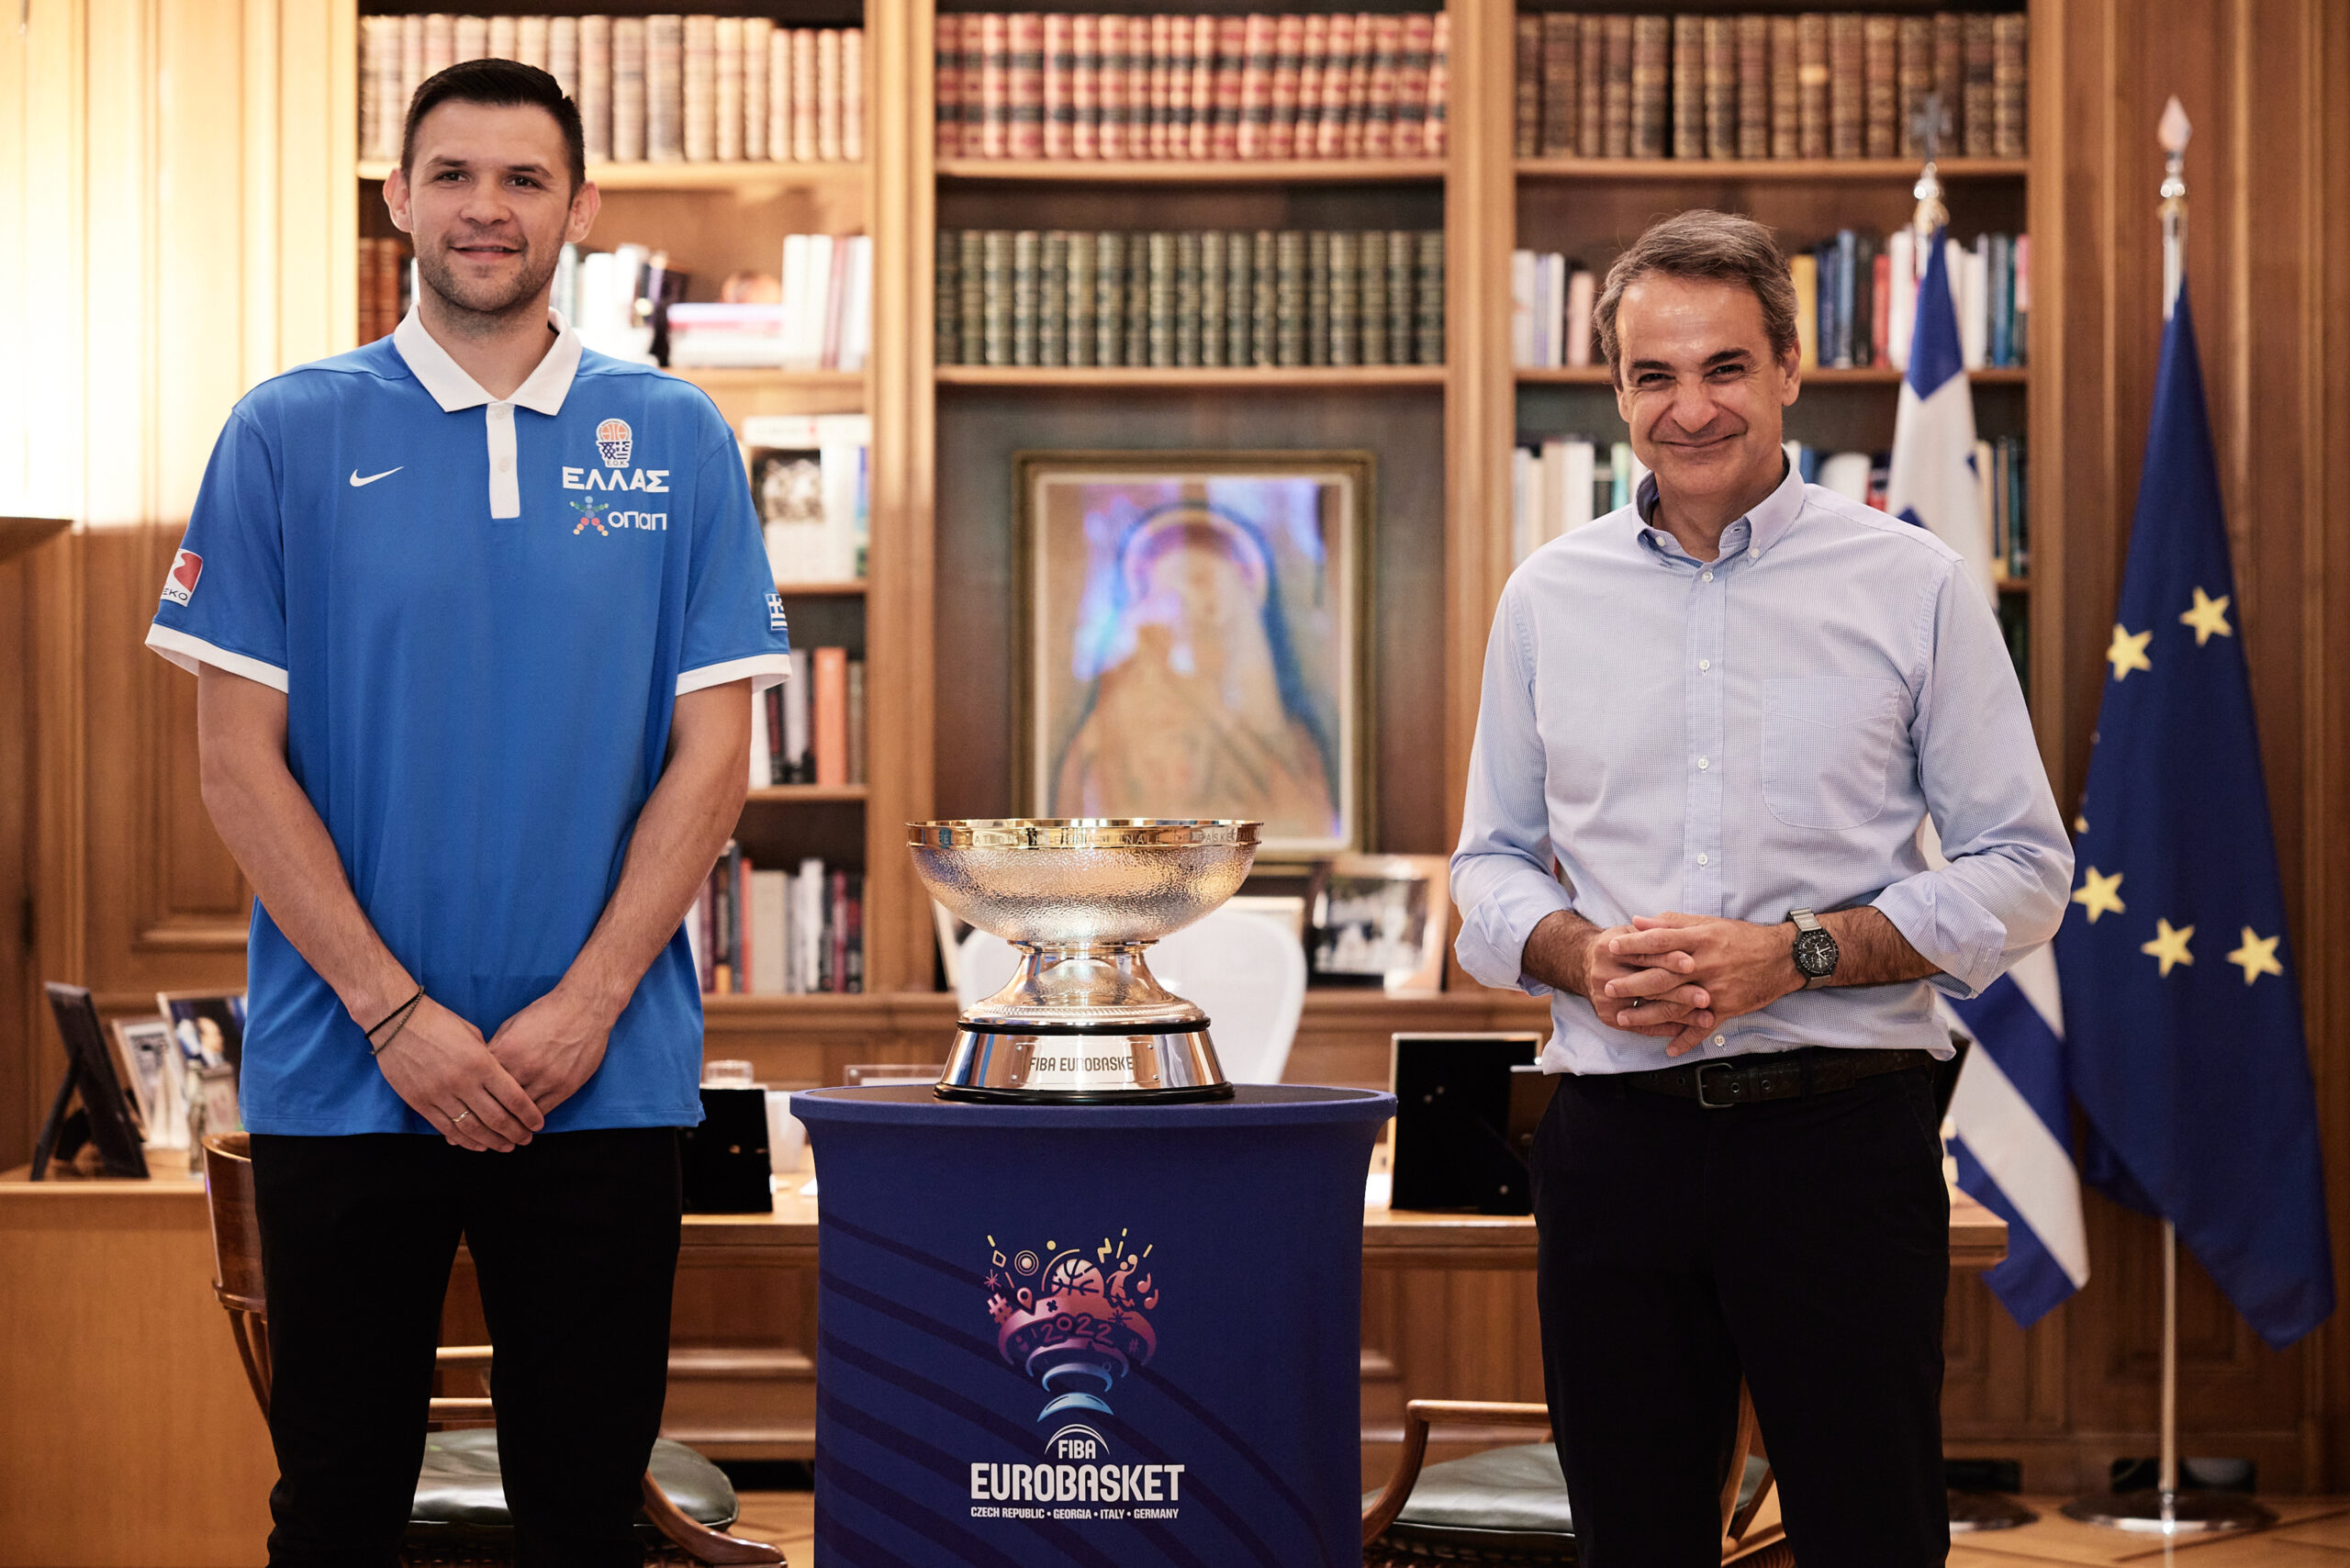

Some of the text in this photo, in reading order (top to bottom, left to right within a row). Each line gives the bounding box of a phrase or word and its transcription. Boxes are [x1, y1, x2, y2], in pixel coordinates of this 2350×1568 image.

[562, 466, 670, 493] ΕΛΛΑΣ
[1029, 1056, 1140, 1071] FIBA EUROBASKE
[1041, 1316, 1113, 1345] 2022
[1058, 1439, 1096, 1460] FIBA
[970, 1462, 1185, 1502] EUROBASKET
[970, 1506, 1179, 1519] CZECH REPUBLIC GEORGIA ITALY GERMANY
